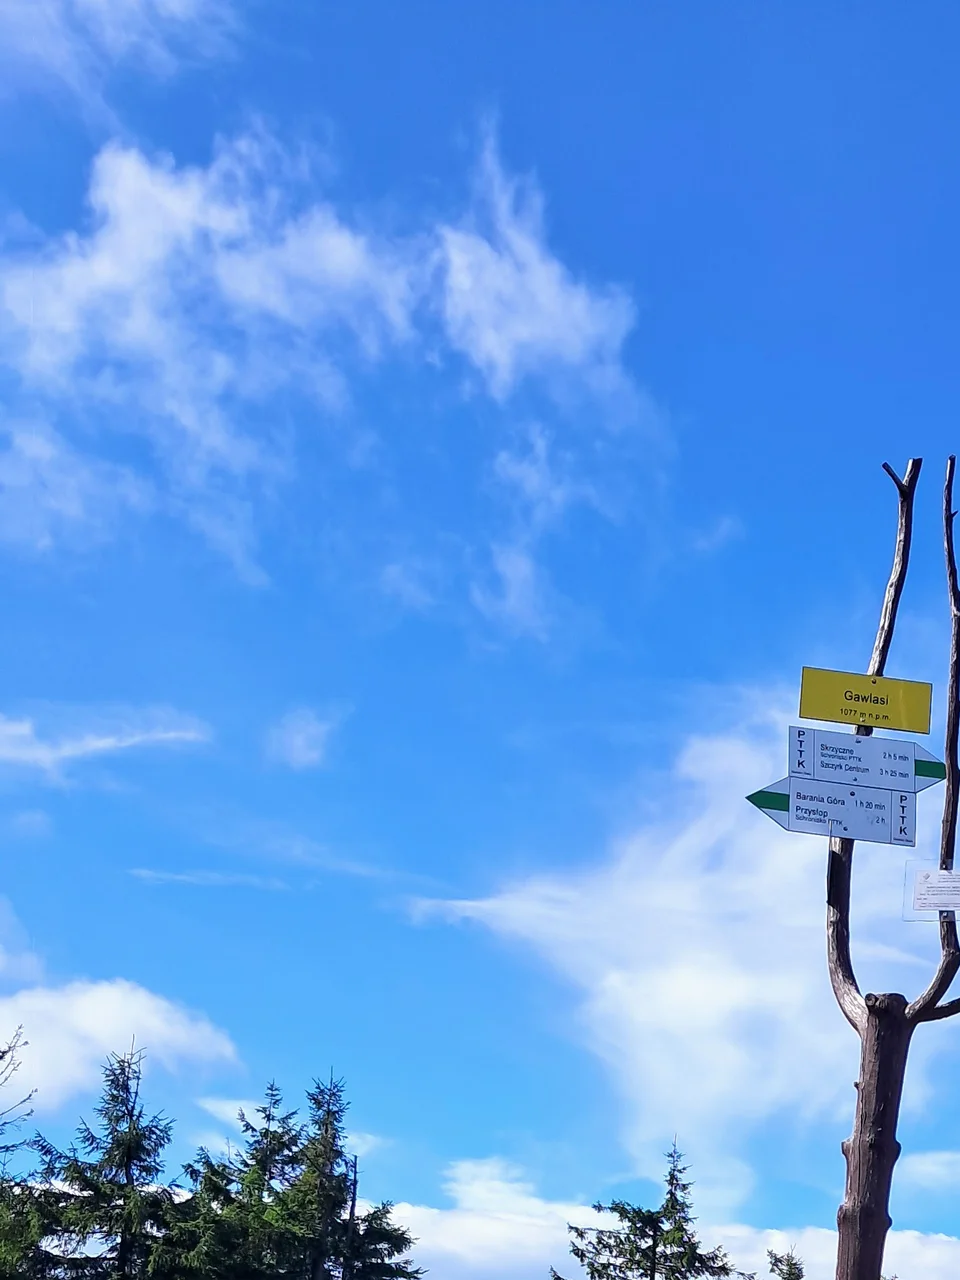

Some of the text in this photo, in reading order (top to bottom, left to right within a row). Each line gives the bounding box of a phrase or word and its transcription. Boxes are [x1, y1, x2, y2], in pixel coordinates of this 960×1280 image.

[844, 690, 889, 706] Gawlasi
[840, 708, 857, 717] 1077
[797, 729, 806, 769] PTTK
[820, 743, 855, 756] Skrzyczne
[898, 754, 910, 762] min
[848, 755, 863, 763] PTTK
[820, 760, 843, 771] Szczyrk
[844, 763, 870, 774] Centrum
[889, 769, 898, 777] 25
[898, 770, 910, 779] min
[795, 791, 825, 804] Barania
[826, 796, 846, 806] Góra
[865, 801, 873, 810] 20
[874, 802, 886, 811] min
[875, 816, 880, 824] 2
[899, 794, 908, 836] PTTK
